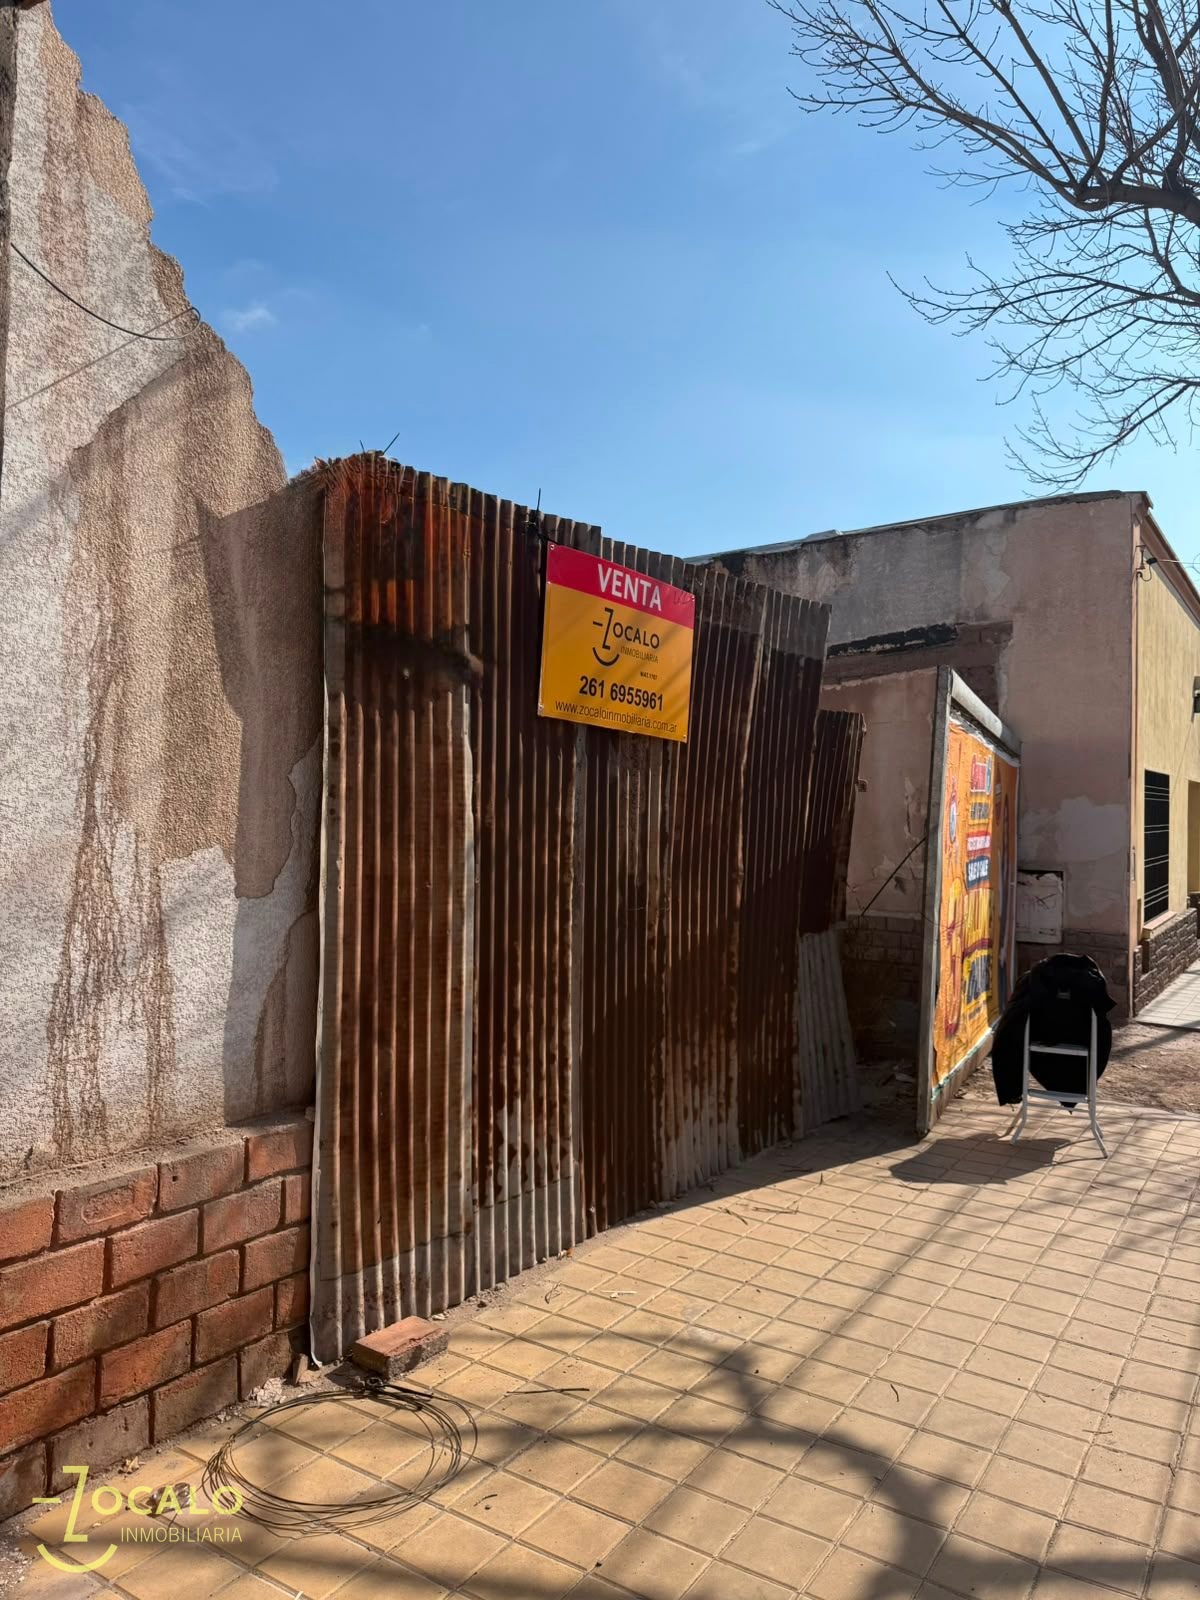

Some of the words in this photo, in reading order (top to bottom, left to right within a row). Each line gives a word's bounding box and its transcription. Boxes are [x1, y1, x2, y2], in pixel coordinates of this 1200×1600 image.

[597, 563, 662, 612] VENTA
[602, 607, 660, 651] ZOCALO
[620, 646, 659, 663] INMOBILIARIA
[579, 675, 604, 698] 261
[610, 683, 663, 712] 6955961
[555, 701, 677, 733] www.zocaloinmobiliaria.com.ar
